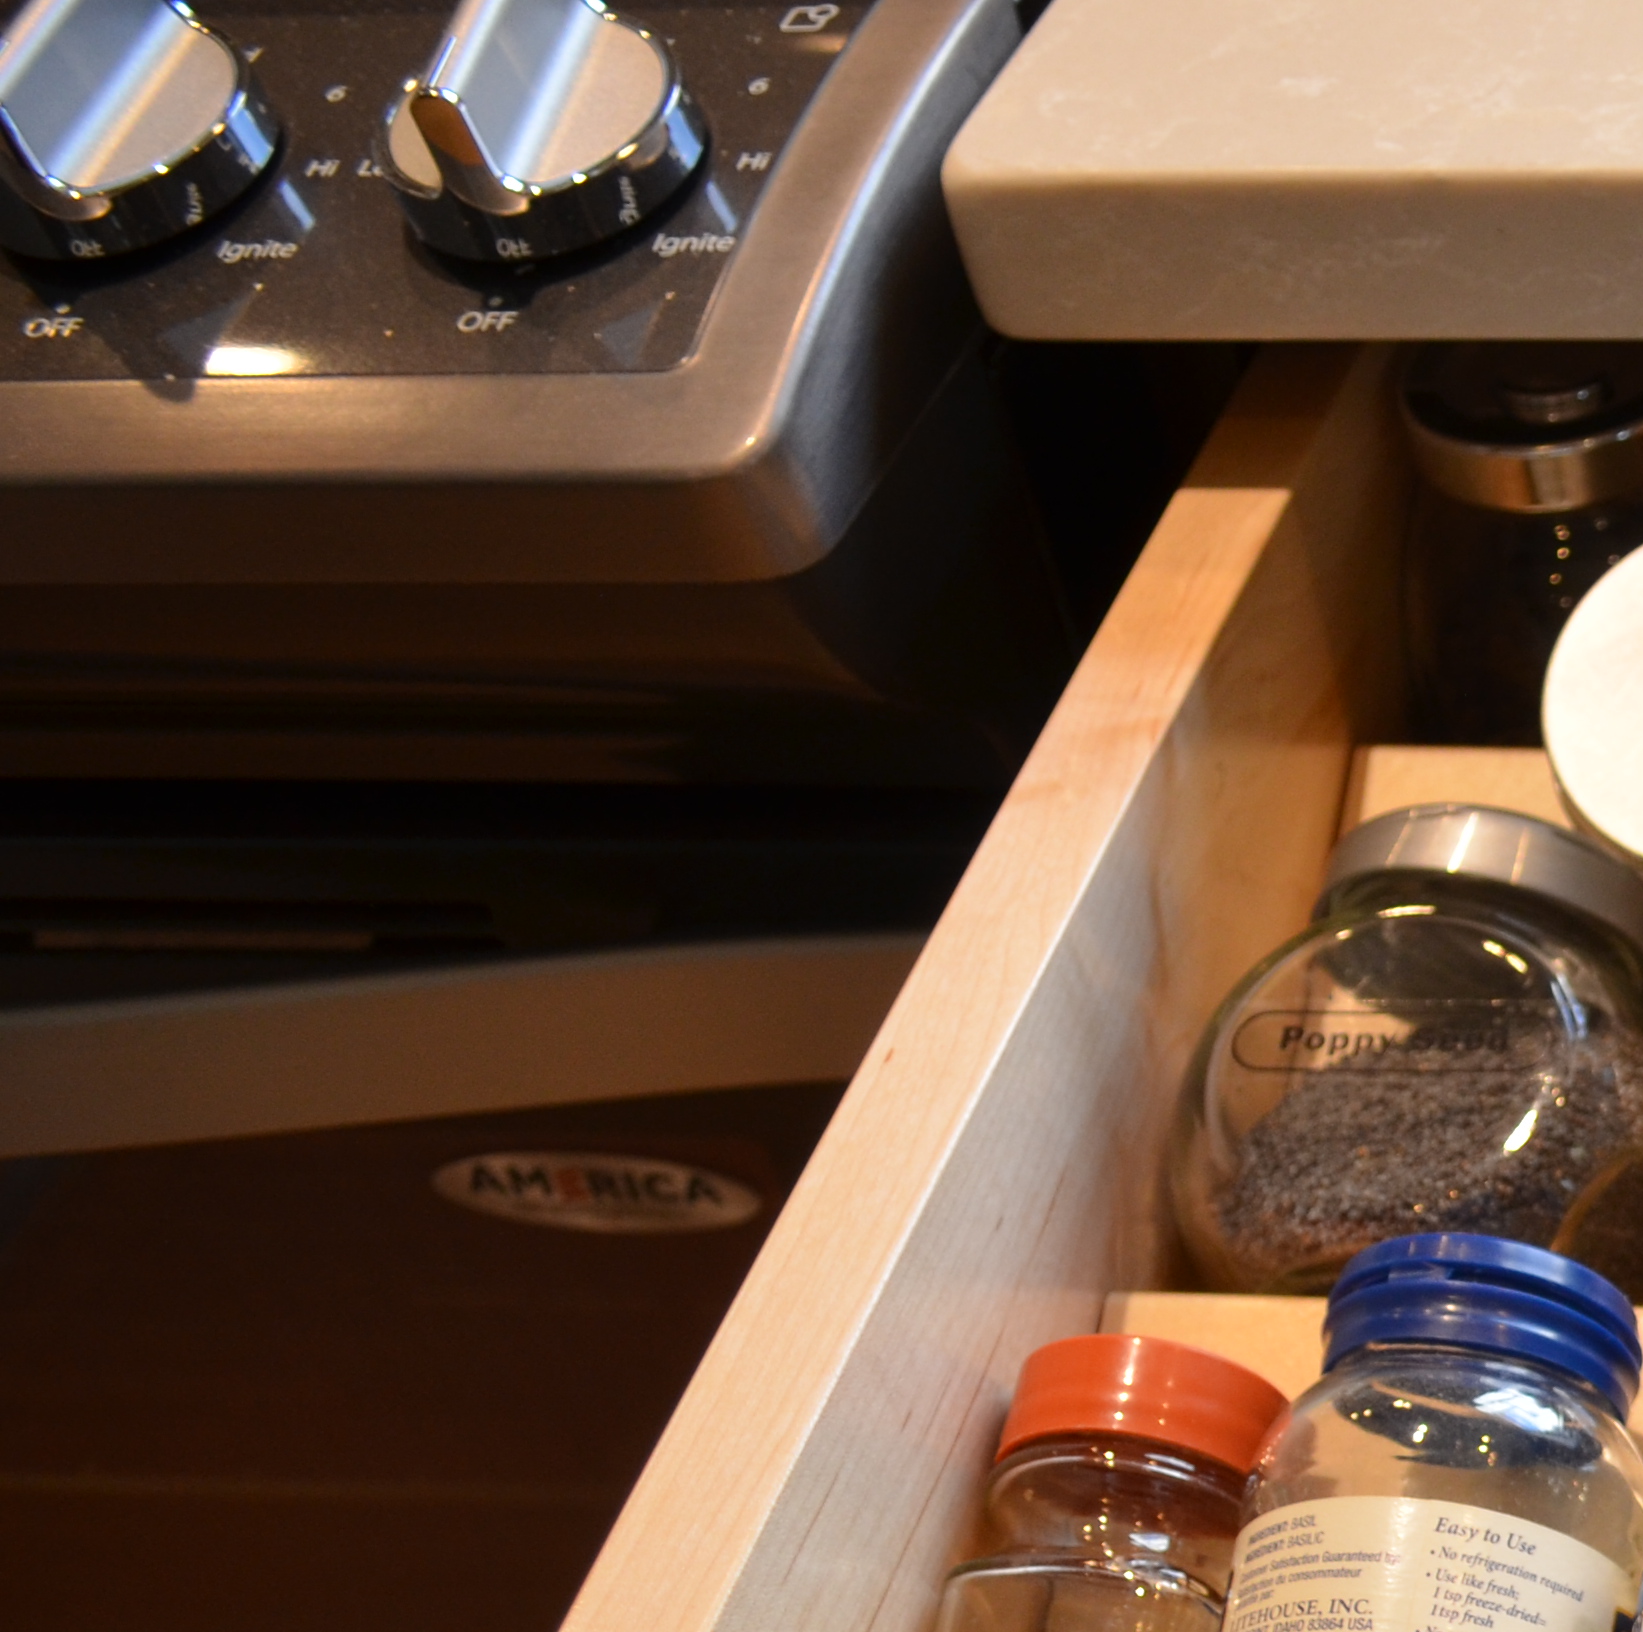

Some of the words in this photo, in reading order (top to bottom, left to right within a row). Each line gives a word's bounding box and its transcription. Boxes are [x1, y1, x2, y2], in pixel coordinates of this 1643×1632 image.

[305, 159, 340, 177] Hi
[736, 152, 771, 172] Hi
[216, 240, 298, 263] Ignite
[652, 234, 736, 257] Ignite
[23, 317, 85, 338] OFF
[457, 311, 519, 333] OFF
[1280, 1025, 1396, 1056] Poppy
[1434, 1517, 1480, 1541] Easy
[1484, 1527, 1500, 1544] to
[1507, 1533, 1538, 1555] Use
[1436, 1569, 1457, 1583] Use
[1462, 1572, 1484, 1589] like
[1439, 1546, 1457, 1560] No
[1461, 1549, 1538, 1583] refrigeration
[1540, 1576, 1585, 1603] required
[1444, 1588, 1462, 1604] tsp
[1329, 1598, 1373, 1616] INC.
[1440, 1605, 1459, 1622] tsp
[1461, 1610, 1494, 1629] fresh
[1348, 1617, 1373, 1632] USA
